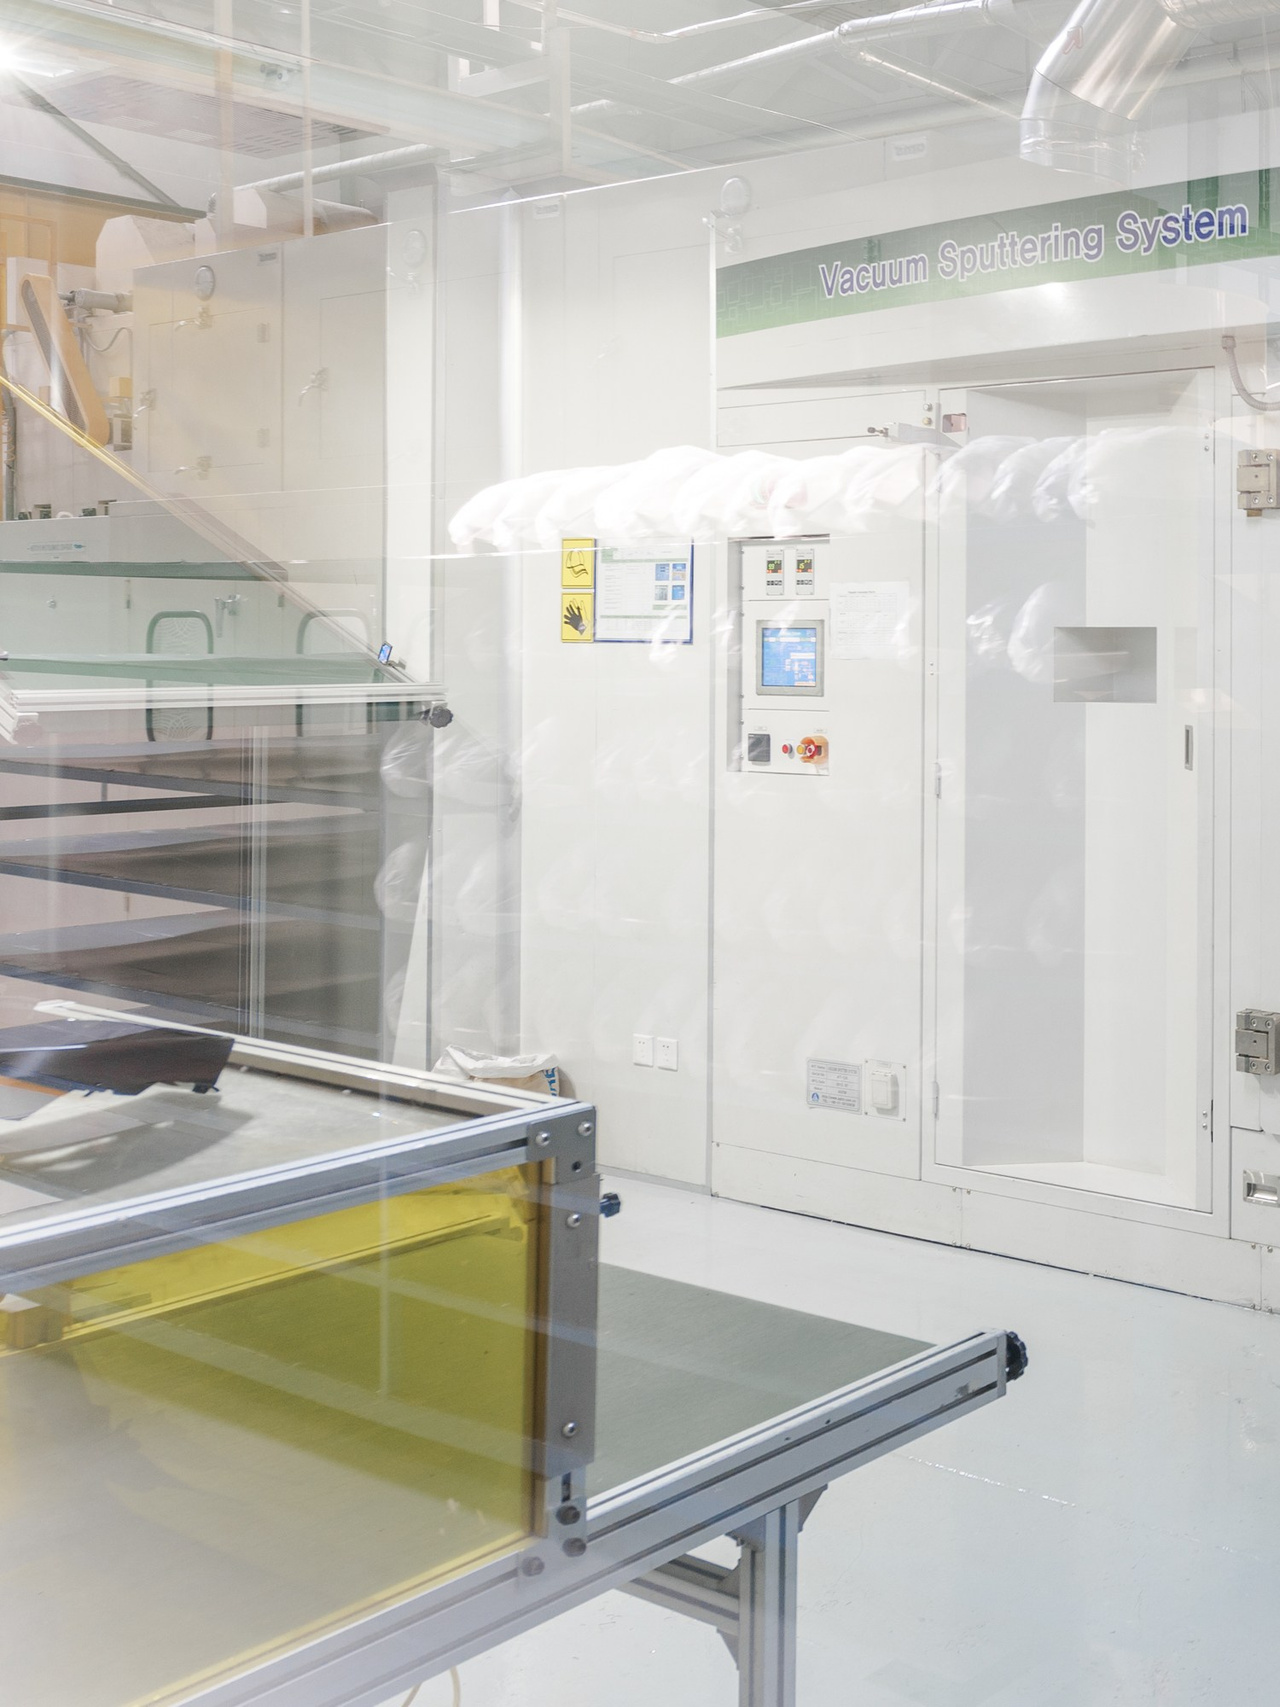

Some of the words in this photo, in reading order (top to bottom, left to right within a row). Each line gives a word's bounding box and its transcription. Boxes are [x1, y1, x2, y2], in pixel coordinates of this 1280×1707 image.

[820, 254, 927, 297] Vacuum
[939, 224, 1104, 280] Sputtering
[1117, 204, 1248, 254] System
